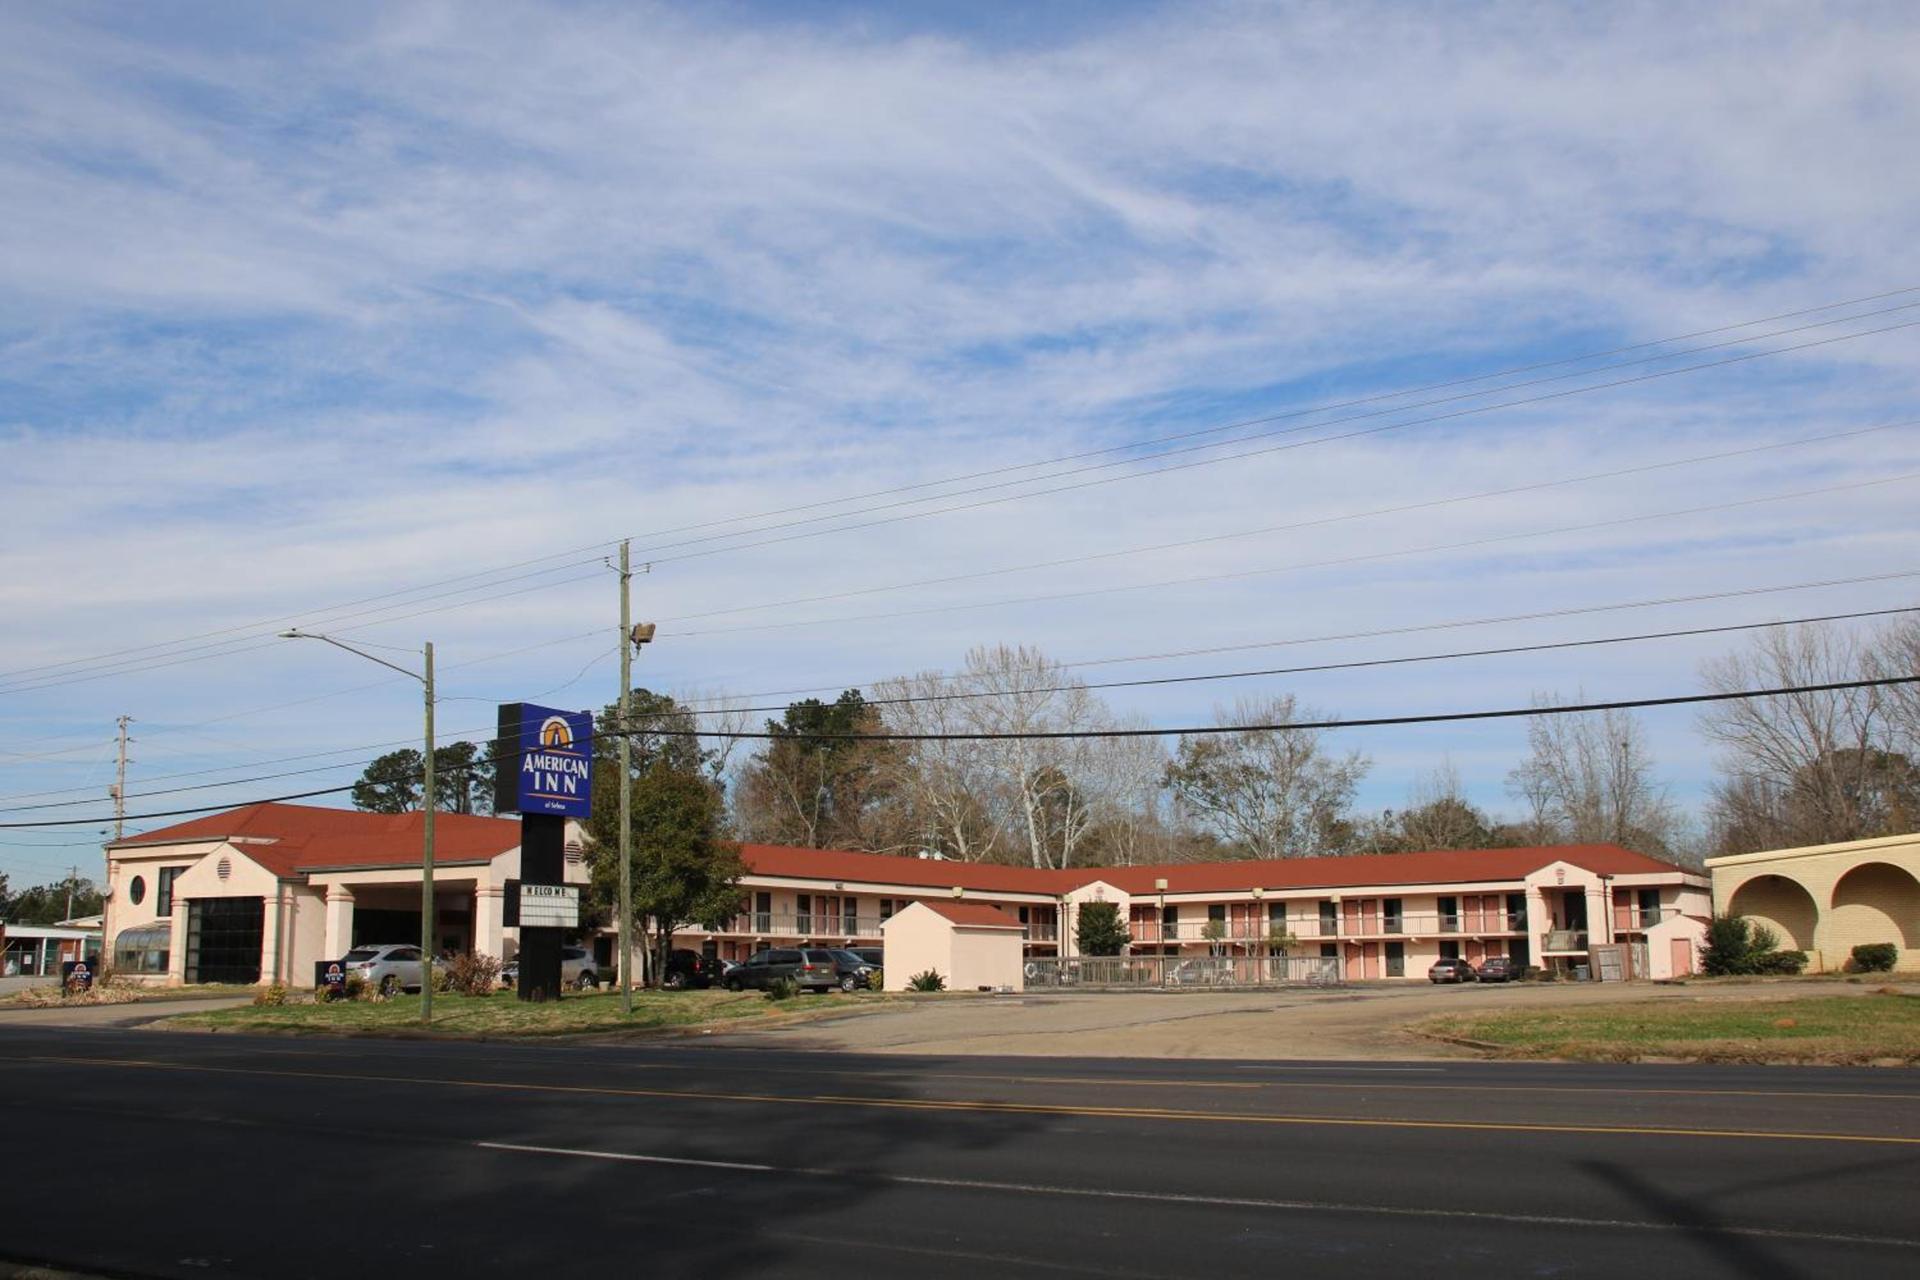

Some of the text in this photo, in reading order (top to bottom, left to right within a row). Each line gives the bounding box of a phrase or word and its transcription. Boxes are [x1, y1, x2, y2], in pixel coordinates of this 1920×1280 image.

[523, 753, 588, 779] AMERICAN
[534, 771, 576, 794] INN
[527, 886, 566, 896] WELCOME
